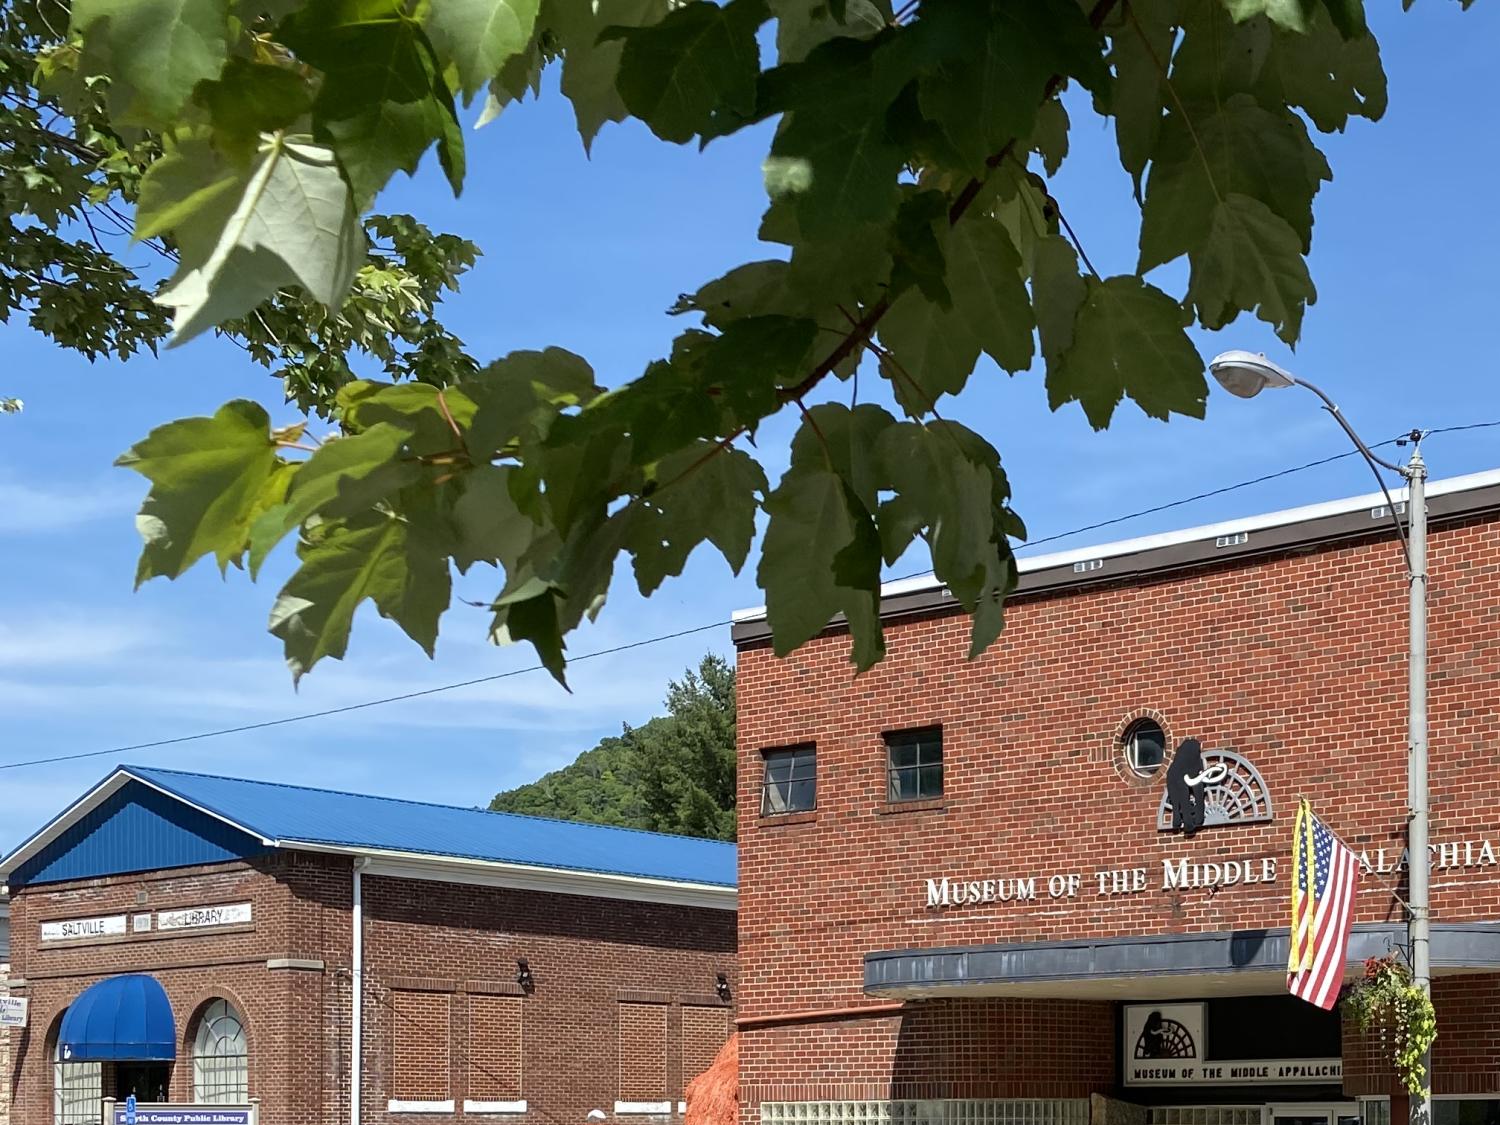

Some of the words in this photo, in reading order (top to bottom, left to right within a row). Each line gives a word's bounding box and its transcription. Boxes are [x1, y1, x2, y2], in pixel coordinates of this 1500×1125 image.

[925, 878, 1035, 907] MUSEUM
[1048, 874, 1081, 898] OF
[1095, 868, 1147, 895] THE
[1162, 857, 1278, 891] MIDDLE
[62, 920, 105, 936] SALTVILLE
[183, 909, 223, 926] LIBRARY
[1134, 1068, 1176, 1079] MUSEUM
[1181, 1068, 1194, 1079] OF
[1203, 1068, 1222, 1078] THE
[1231, 1066, 1269, 1078] MIDDLE
[1279, 1066, 1343, 1077] APPALACHI
[120, 1115, 149, 1124] Syth
[151, 1115, 182, 1124] County
[184, 1114, 211, 1123] Public
[213, 1114, 244, 1123] Library
